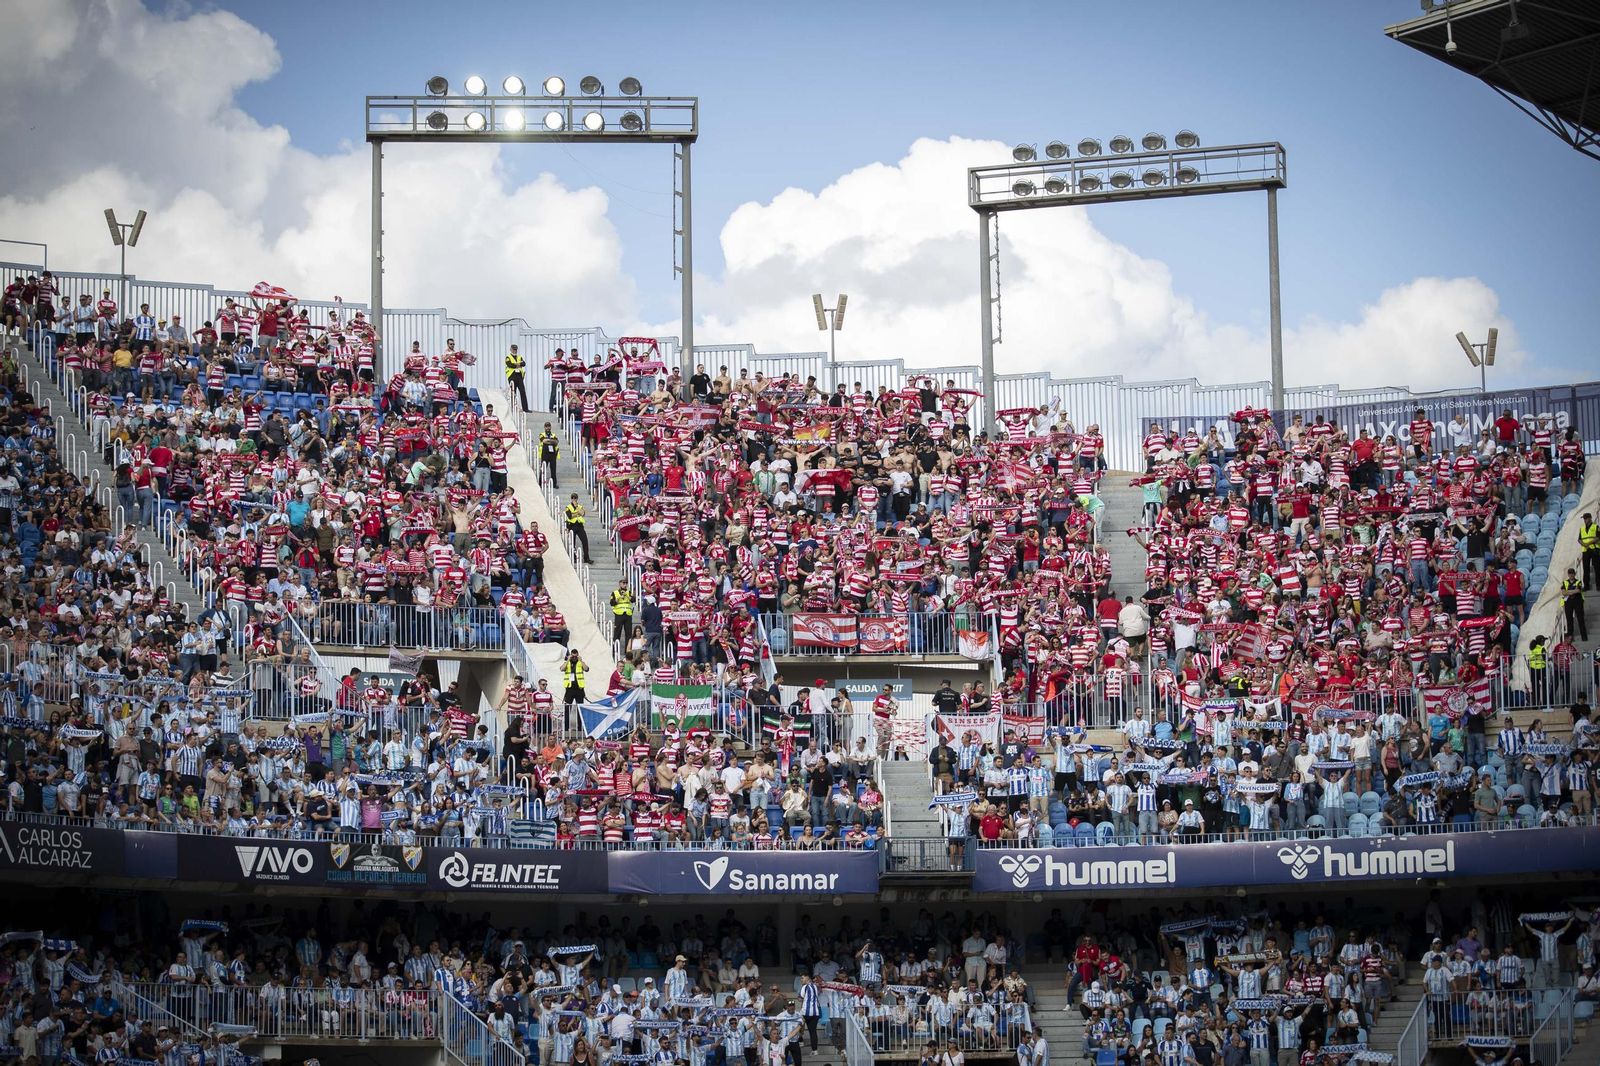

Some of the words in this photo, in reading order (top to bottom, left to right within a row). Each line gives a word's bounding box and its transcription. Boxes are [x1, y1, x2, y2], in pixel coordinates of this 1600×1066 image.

[1359, 406, 1402, 417] Universidad
[1404, 404, 1433, 413] Alfonso
[1441, 402, 1448, 410] el
[1449, 400, 1471, 409] Sabio
[1473, 398, 1493, 407] Mare
[1494, 396, 1528, 405] Nostrum
[845, 684, 877, 693] SALIDA
[891, 684, 904, 693] XIT
[1238, 783, 1275, 791] INVENCIBLES
[1405, 771, 1440, 784] MALAGA
[18, 827, 82, 849] CARLOS
[18, 847, 92, 868] ALCARAZ
[1323, 840, 1456, 877] hummel
[471, 863, 561, 883] FB.INTEC
[1045, 851, 1176, 886] hummel
[729, 869, 839, 890] Sanamar
[1237, 999, 1274, 1008] MALAGA
[1321, 1044, 1363, 1053] MALAGA
